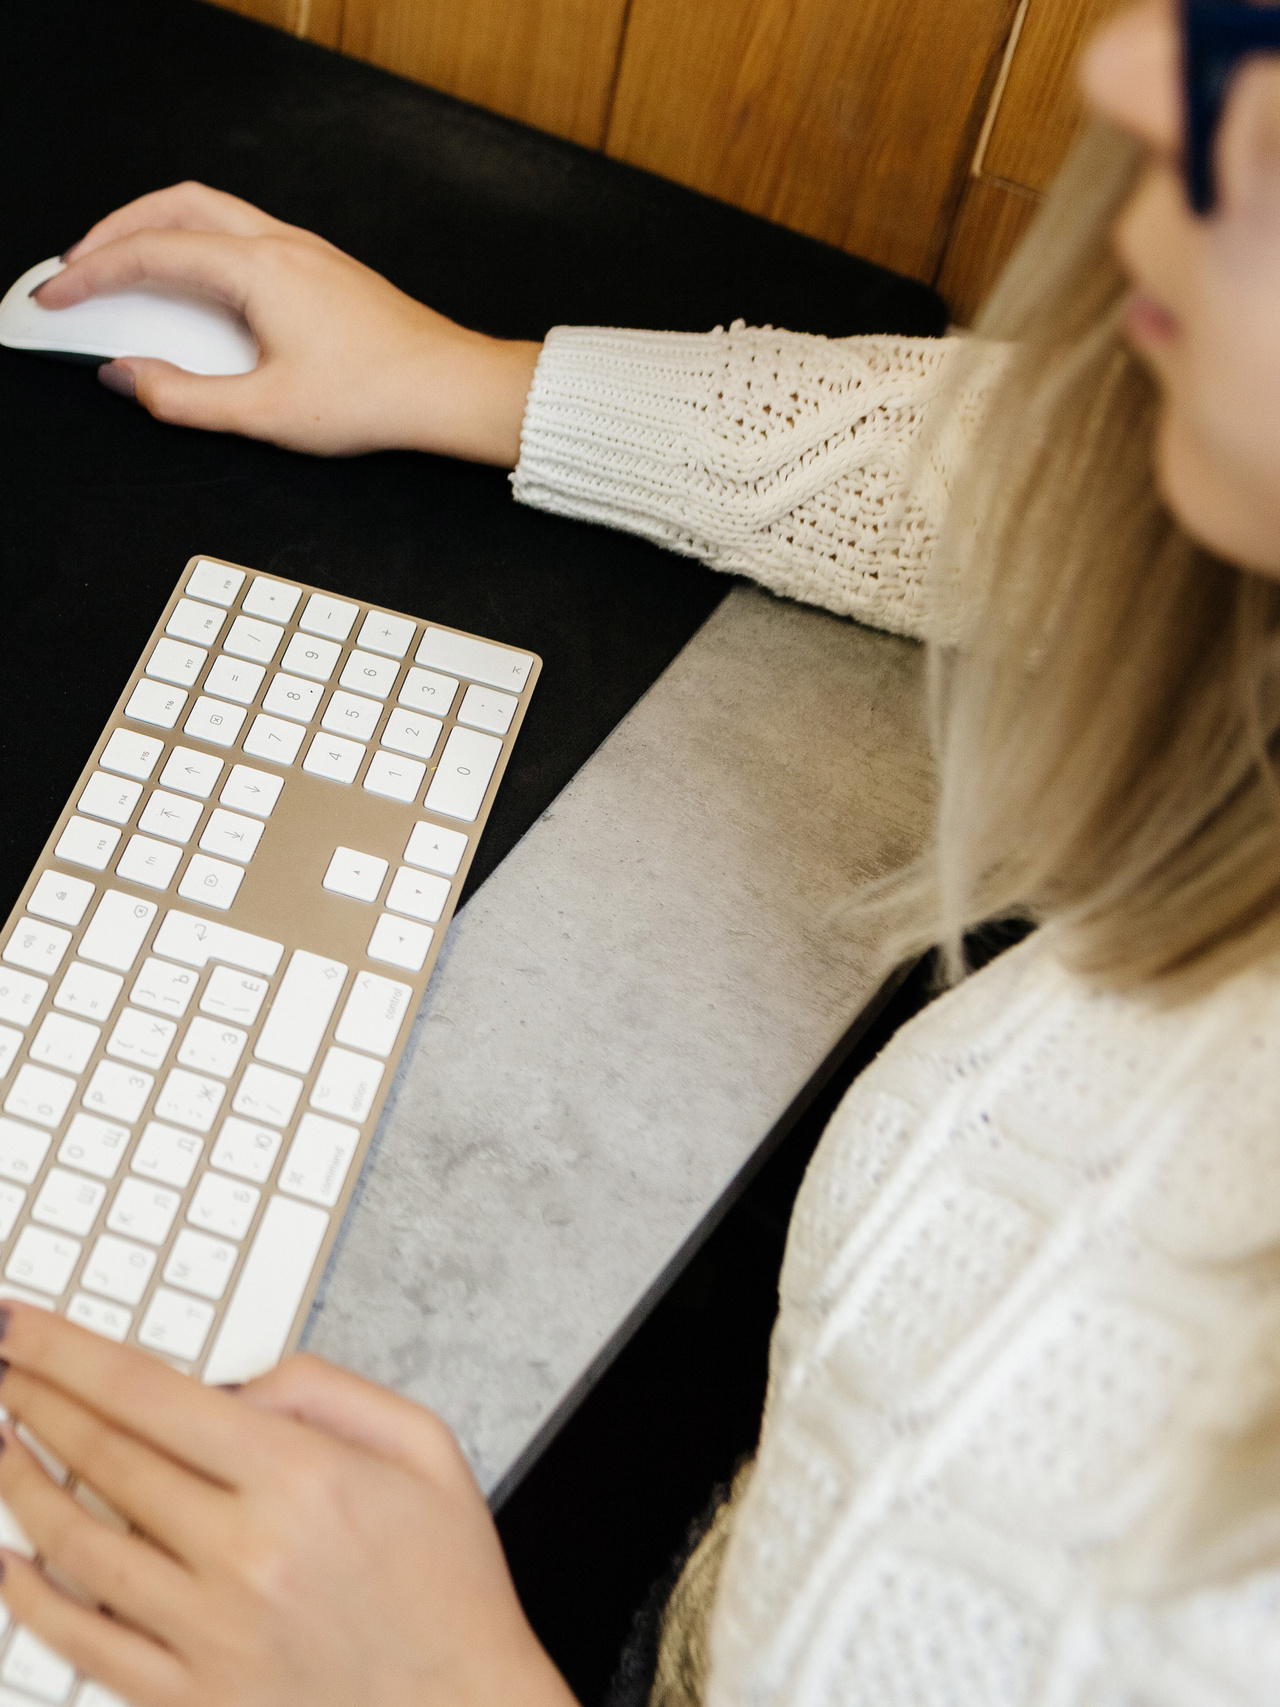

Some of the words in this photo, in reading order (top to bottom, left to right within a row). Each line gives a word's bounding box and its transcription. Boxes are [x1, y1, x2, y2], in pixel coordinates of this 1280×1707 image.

[305, 651, 319, 660] 9
[363, 668, 377, 677] 6
[421, 686, 436, 695] 3
[286, 691, 301, 701] 8
[165, 700, 175, 710] F16
[345, 709, 360, 719] 5
[405, 727, 420, 737] 2
[268, 733, 282, 743] 7
[328, 751, 343, 761] 4
[456, 766, 471, 776] 0
[118, 794, 128, 805] F14
[96, 839, 107, 850] F13
[145, 856, 157, 866] fn
[385, 987, 404, 1020] control
[351, 1081, 368, 1113] option
[321, 1145, 346, 1196] command
